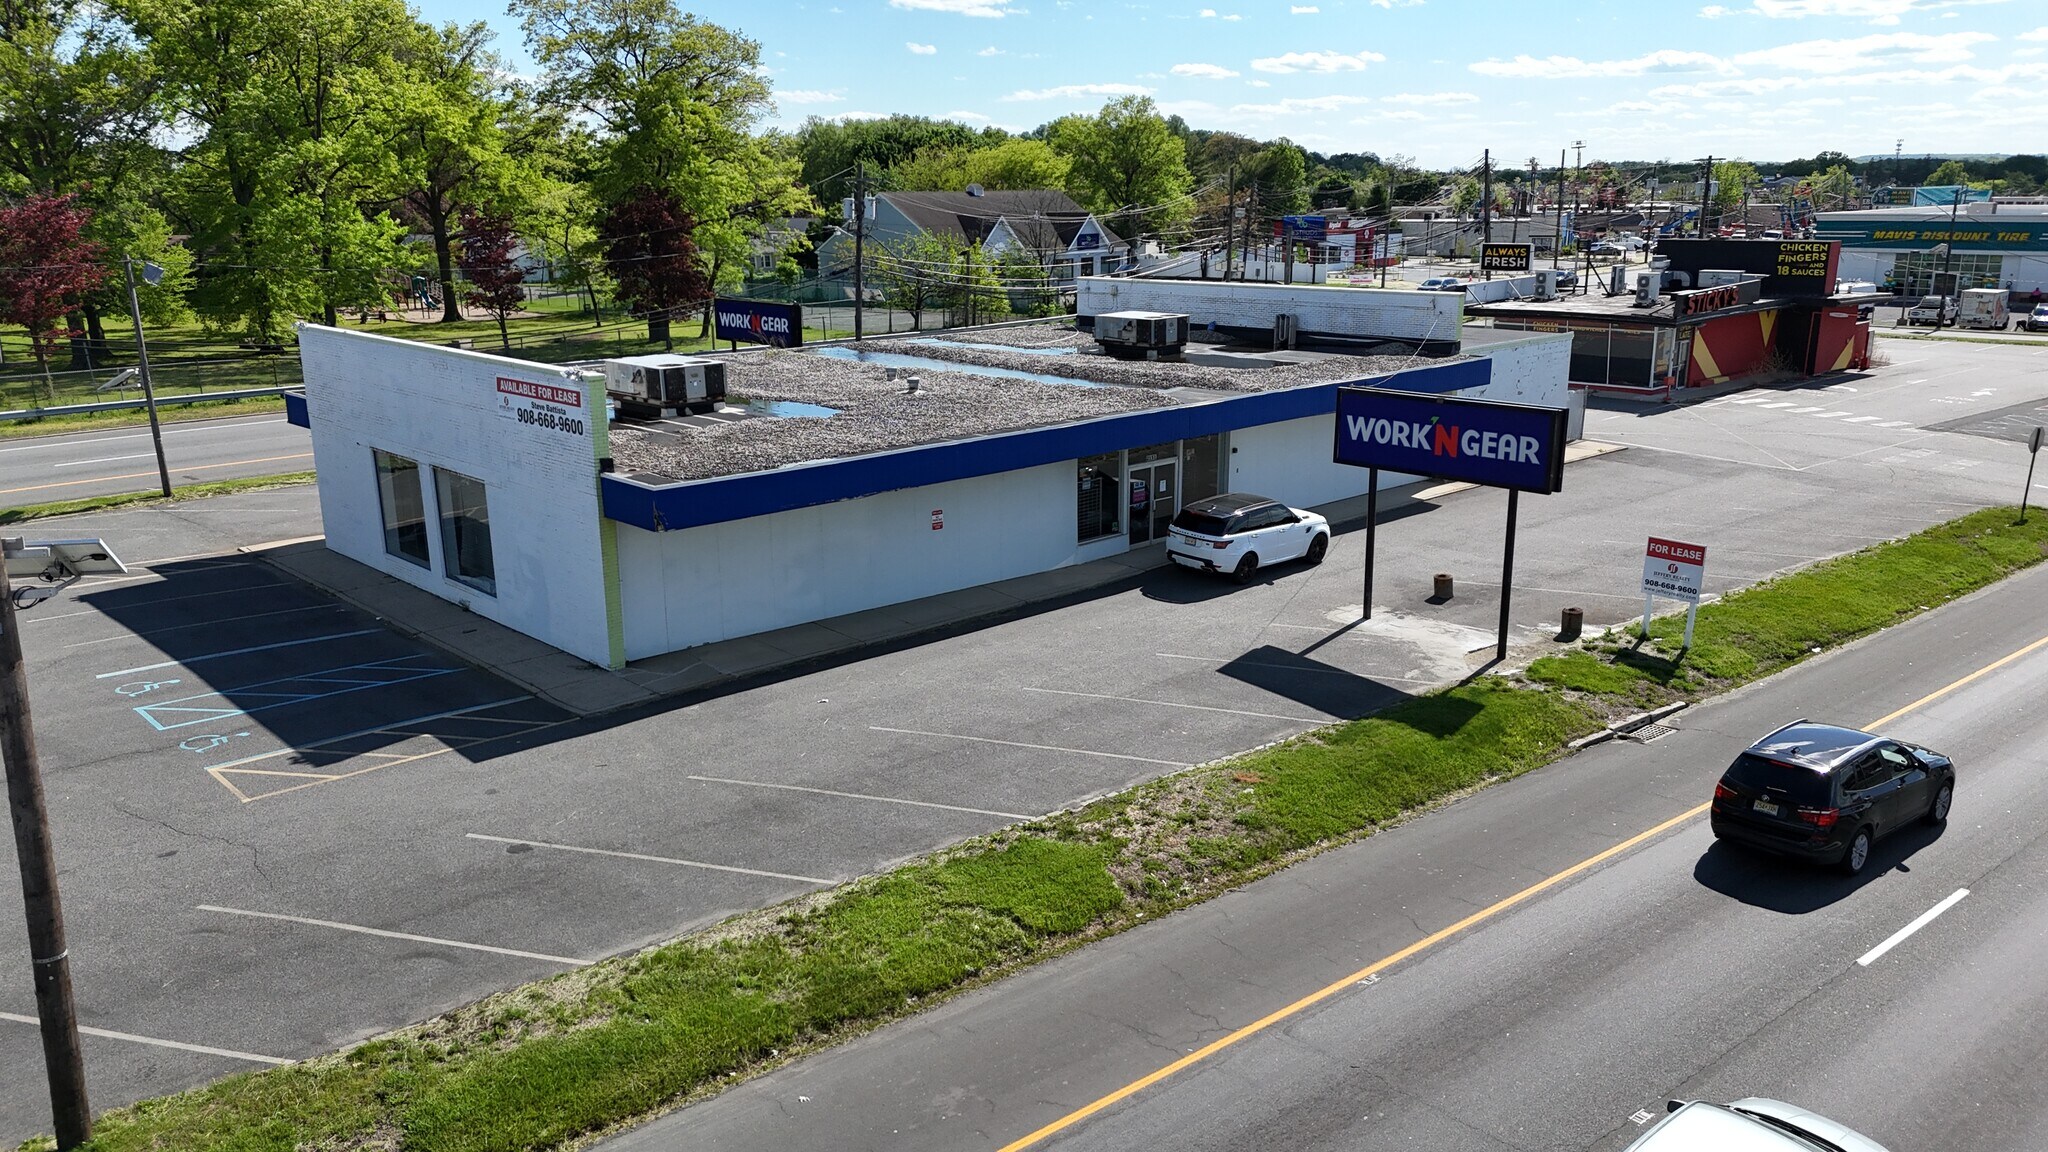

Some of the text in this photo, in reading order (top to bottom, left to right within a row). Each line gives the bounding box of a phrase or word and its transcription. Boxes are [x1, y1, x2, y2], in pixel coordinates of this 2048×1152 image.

[1873, 230, 2031, 241] MAVIS DISCOUNT TIRE
[1485, 248, 1527, 257] ALWAYS
[1780, 243, 1828, 252] CHICKEN
[1484, 257, 1526, 267] FRESH
[1778, 253, 1827, 263] FINGERS
[1777, 265, 1825, 276] 18 SAUCES
[1687, 285, 1740, 315] STICKY'S
[761, 316, 789, 333] GEAR
[500, 379, 578, 405] AVAILABLE FOR LEASE
[531, 401, 566, 415] Steve Battista
[517, 407, 583, 436] 908-668-9600
[1461, 429, 1540, 465] GEAR
[1649, 543, 1702, 561] FOR LEASE
[1644, 579, 1697, 595] 908-668-9600
